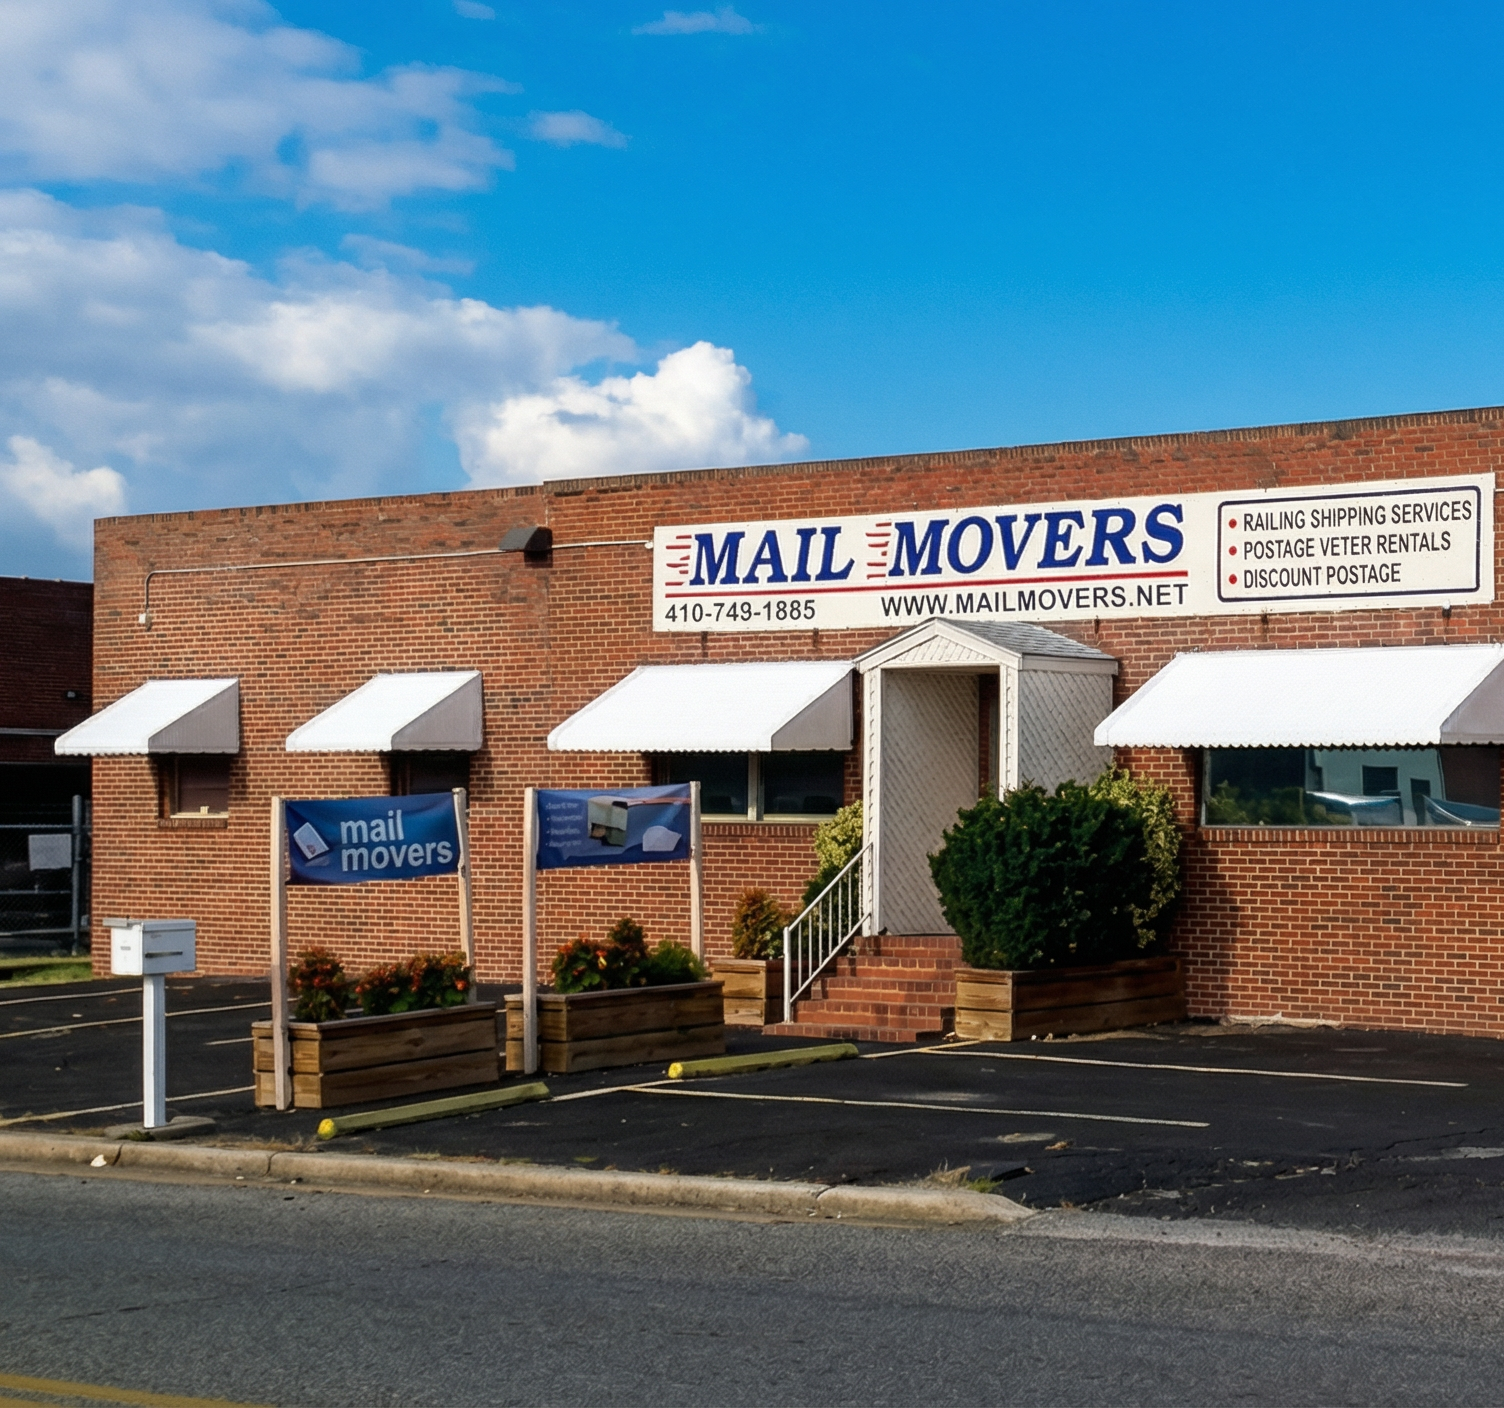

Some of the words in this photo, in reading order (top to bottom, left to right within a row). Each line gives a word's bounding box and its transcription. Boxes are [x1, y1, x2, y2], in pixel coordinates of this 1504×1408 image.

[1244, 510, 1306, 532] RAILING
[1310, 505, 1386, 528] SHIPPING
[1391, 500, 1472, 524] SERVICES
[689, 526, 855, 586] MAIL
[889, 504, 1185, 578] MOVERS
[1244, 537, 1315, 560] POSTAGE
[1320, 534, 1372, 557] VETER
[1377, 531, 1451, 554] RENTALS
[1244, 566, 1321, 589] DISCOUNT
[1327, 563, 1401, 585] POSTAGE
[881, 583, 1189, 616] WWW.MAILMOVERS.NET
[340, 809, 402, 845] mail
[341, 839, 453, 872] movers
